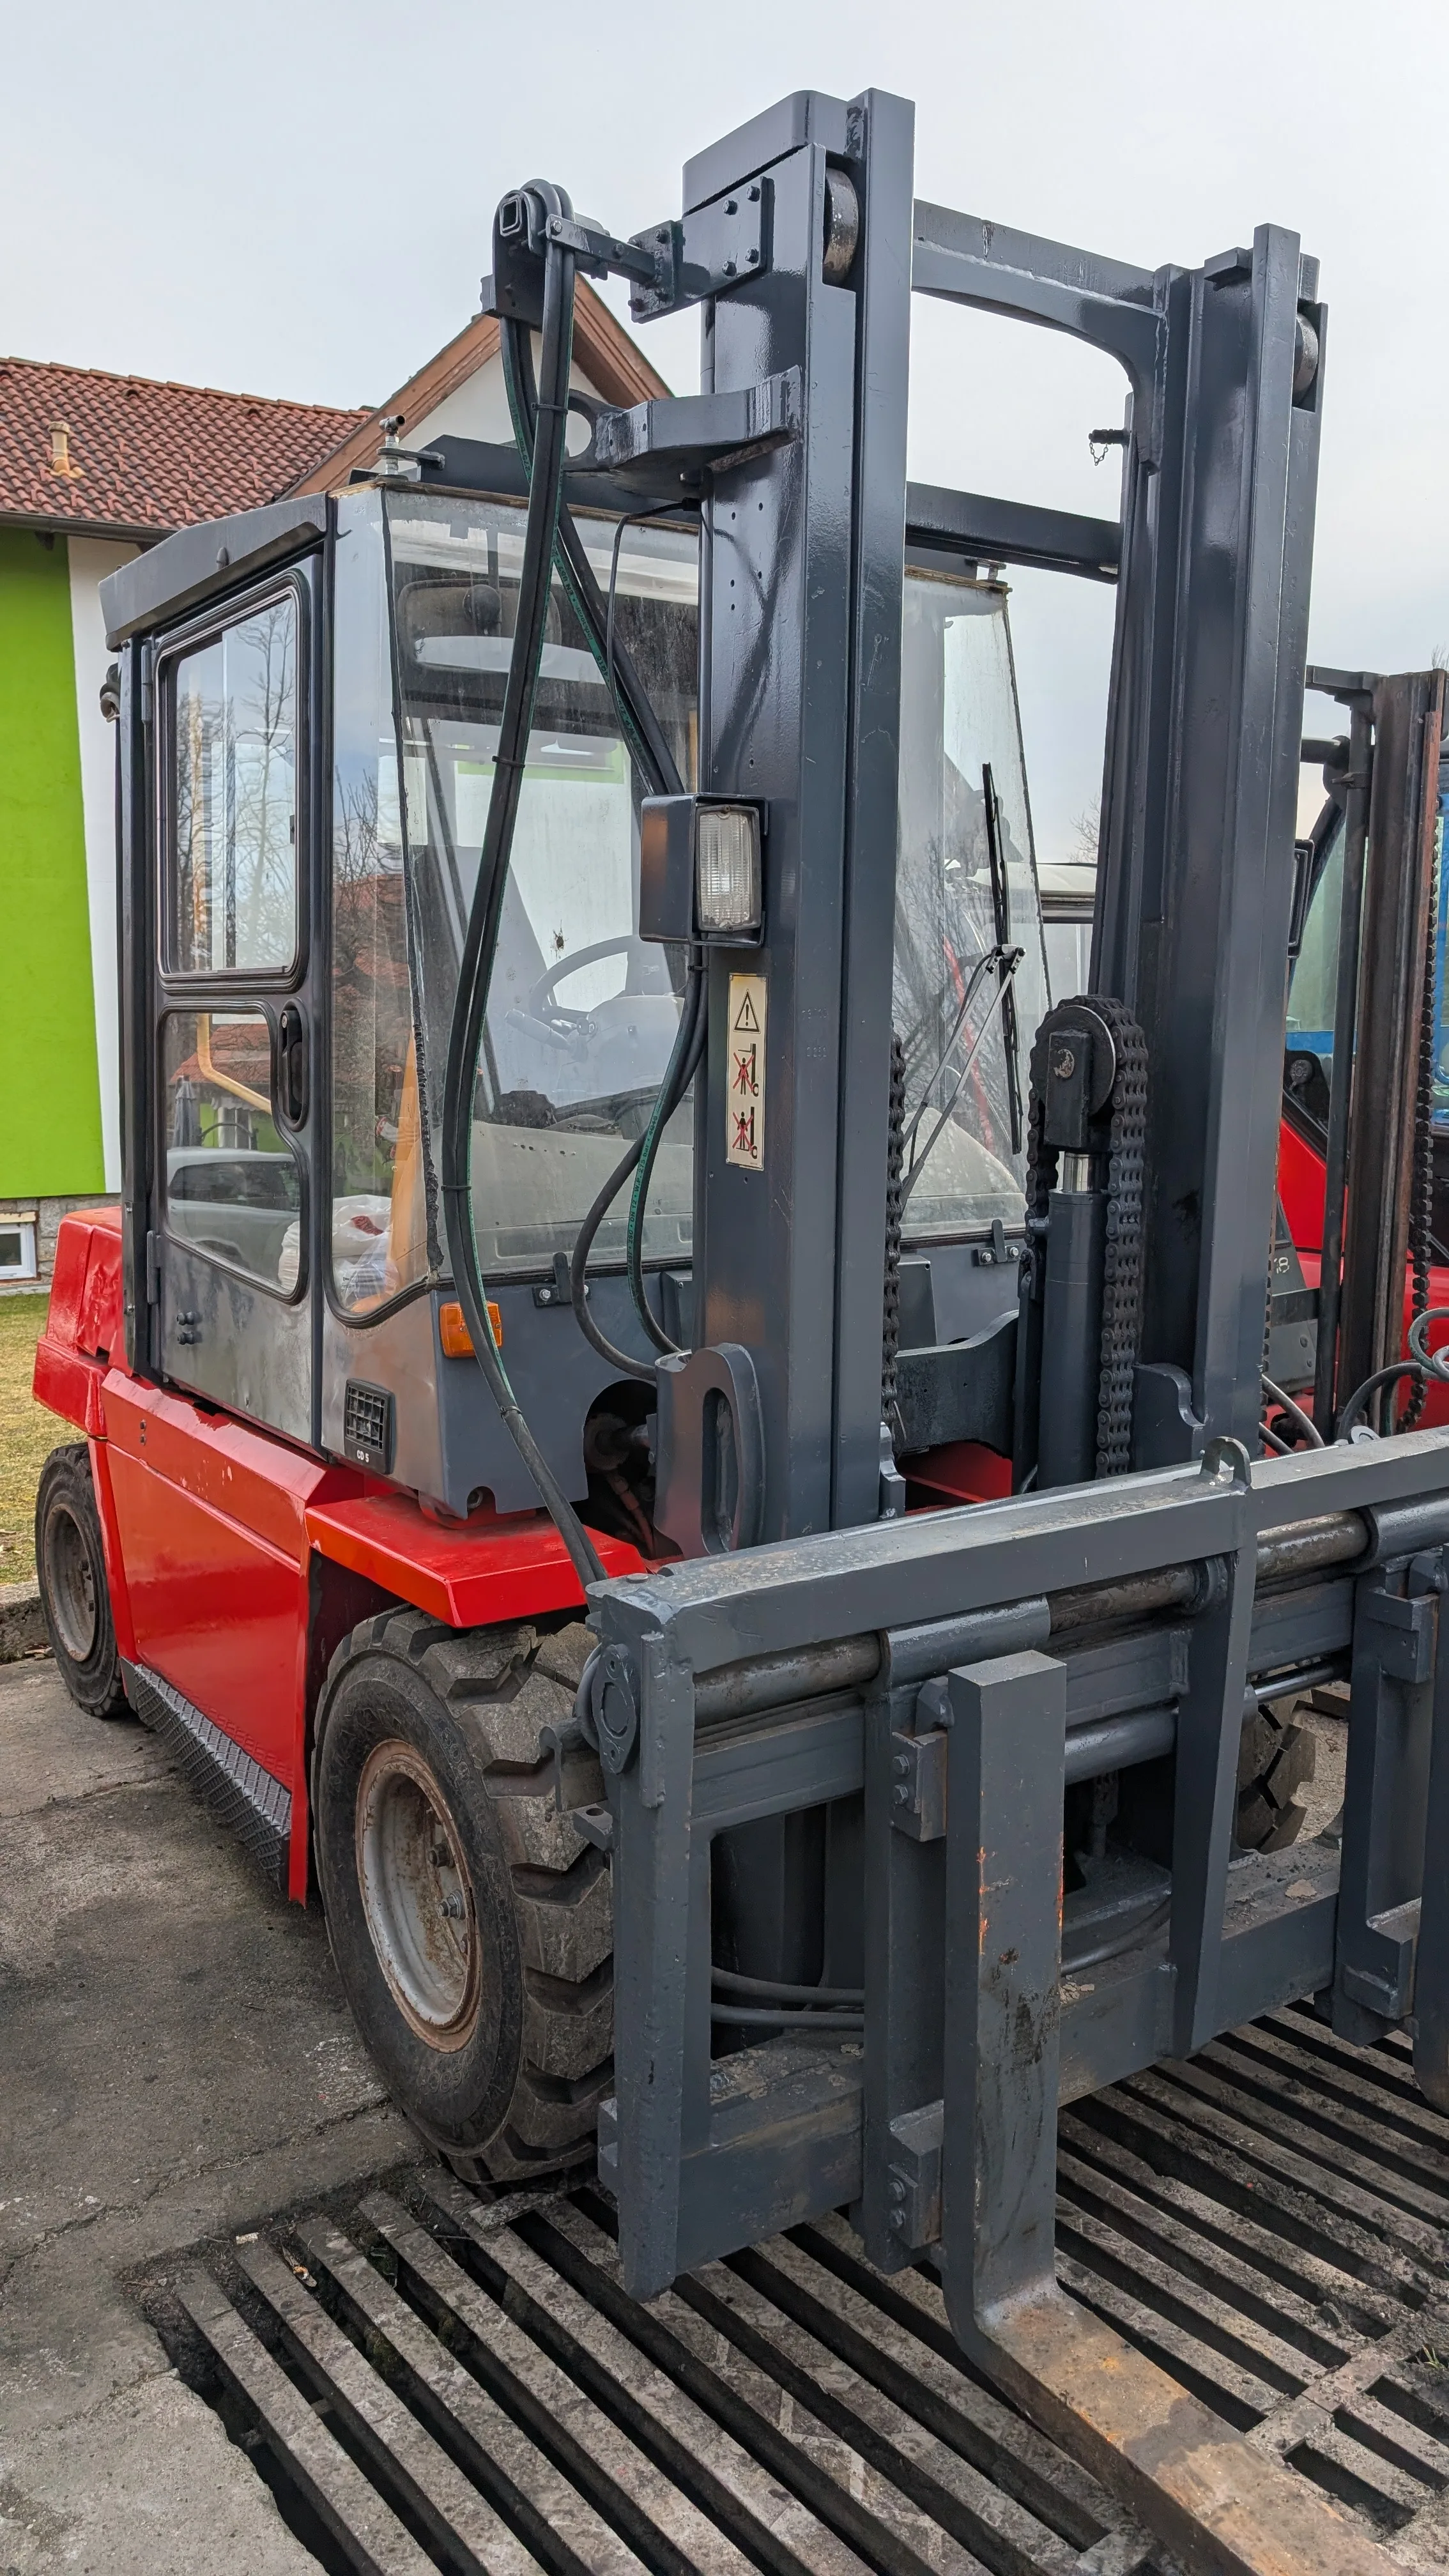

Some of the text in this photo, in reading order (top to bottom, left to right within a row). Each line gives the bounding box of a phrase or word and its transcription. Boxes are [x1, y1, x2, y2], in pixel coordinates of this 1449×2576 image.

[638, 1159, 646, 1174] 275
[356, 1450, 369, 1463] CD 5
